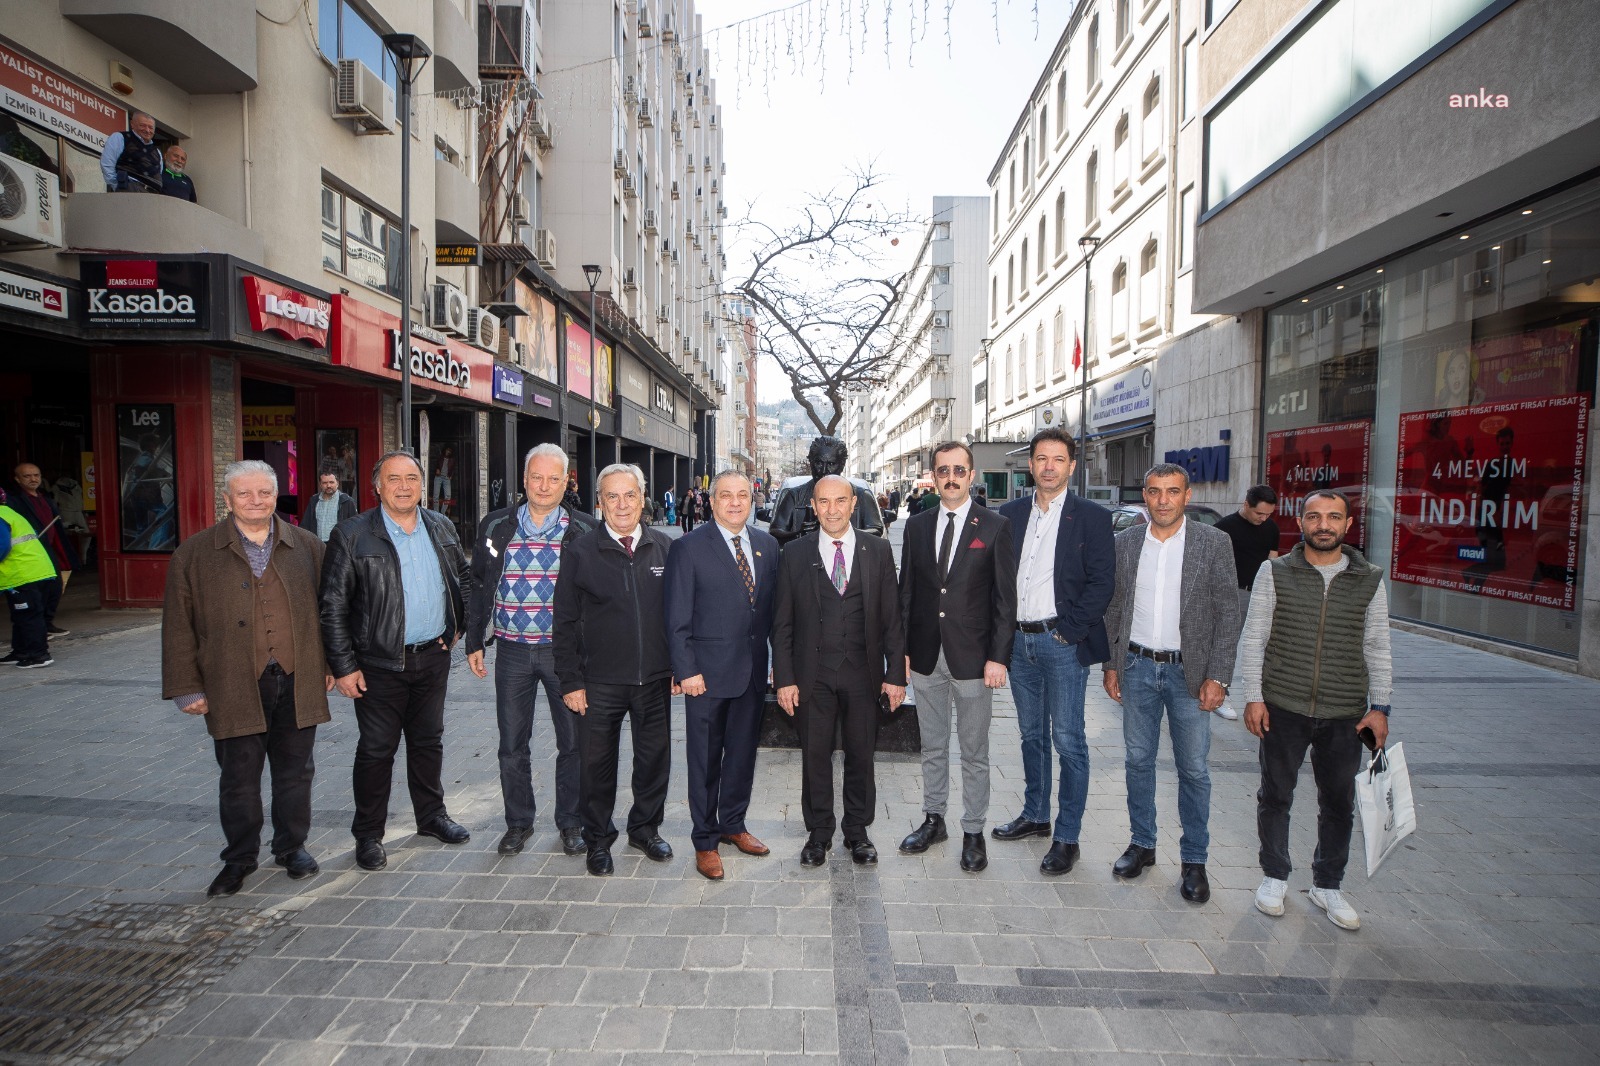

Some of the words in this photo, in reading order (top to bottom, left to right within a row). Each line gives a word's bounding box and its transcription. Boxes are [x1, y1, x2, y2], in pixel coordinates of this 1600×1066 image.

[0, 51, 43, 82] YALİST
[45, 75, 117, 119] CUMHURİYET
[31, 83, 75, 114] PARTİSİ
[5, 93, 37, 117] İZMİR
[39, 108, 49, 122] İL
[51, 117, 105, 148] BAŞKANLIĞ
[35, 171, 51, 221] arçelik
[0, 282, 41, 303] SILVER
[108, 278, 127, 286] JEANS
[128, 278, 155, 286] GALLERY
[88, 288, 196, 314] Kasaba
[131, 409, 160, 426] Lee
[1406, 413, 1425, 421] FIRSAT
[1426, 411, 1447, 420] FIRSAT
[1447, 408, 1468, 418] FIRSAT
[1469, 406, 1492, 415] FIRSAT
[1494, 402, 1519, 412] FIRSAT
[1520, 399, 1547, 409] FIRSAT
[1549, 396, 1578, 407] FIRSAT
[1577, 396, 1587, 429] FIRSAT
[1575, 433, 1585, 465] FIRSAT
[1286, 469, 1292, 482] 4
[1294, 463, 1339, 481] MEVSİM
[1432, 462, 1442, 479] 4
[1448, 454, 1527, 479] MEVSİM
[1572, 468, 1582, 501] FIRSAT
[1419, 492, 1539, 531] İNDİRİM
[1569, 504, 1579, 537] FIRSAT
[1459, 548, 1485, 560] mavi
[1566, 540, 1577, 572] FIRSAT
[1397, 572, 1415, 581] FIRSAT
[1416, 575, 1436, 585] FIRSAT
[1436, 579, 1458, 589] FIRSAT
[1458, 582, 1481, 592] FIRSAT
[1481, 586, 1506, 597] FIRSAT
[1507, 590, 1533, 601] FIRSAT
[1535, 594, 1563, 606] FIRSAT
[1564, 575, 1574, 608] FIRSAT
